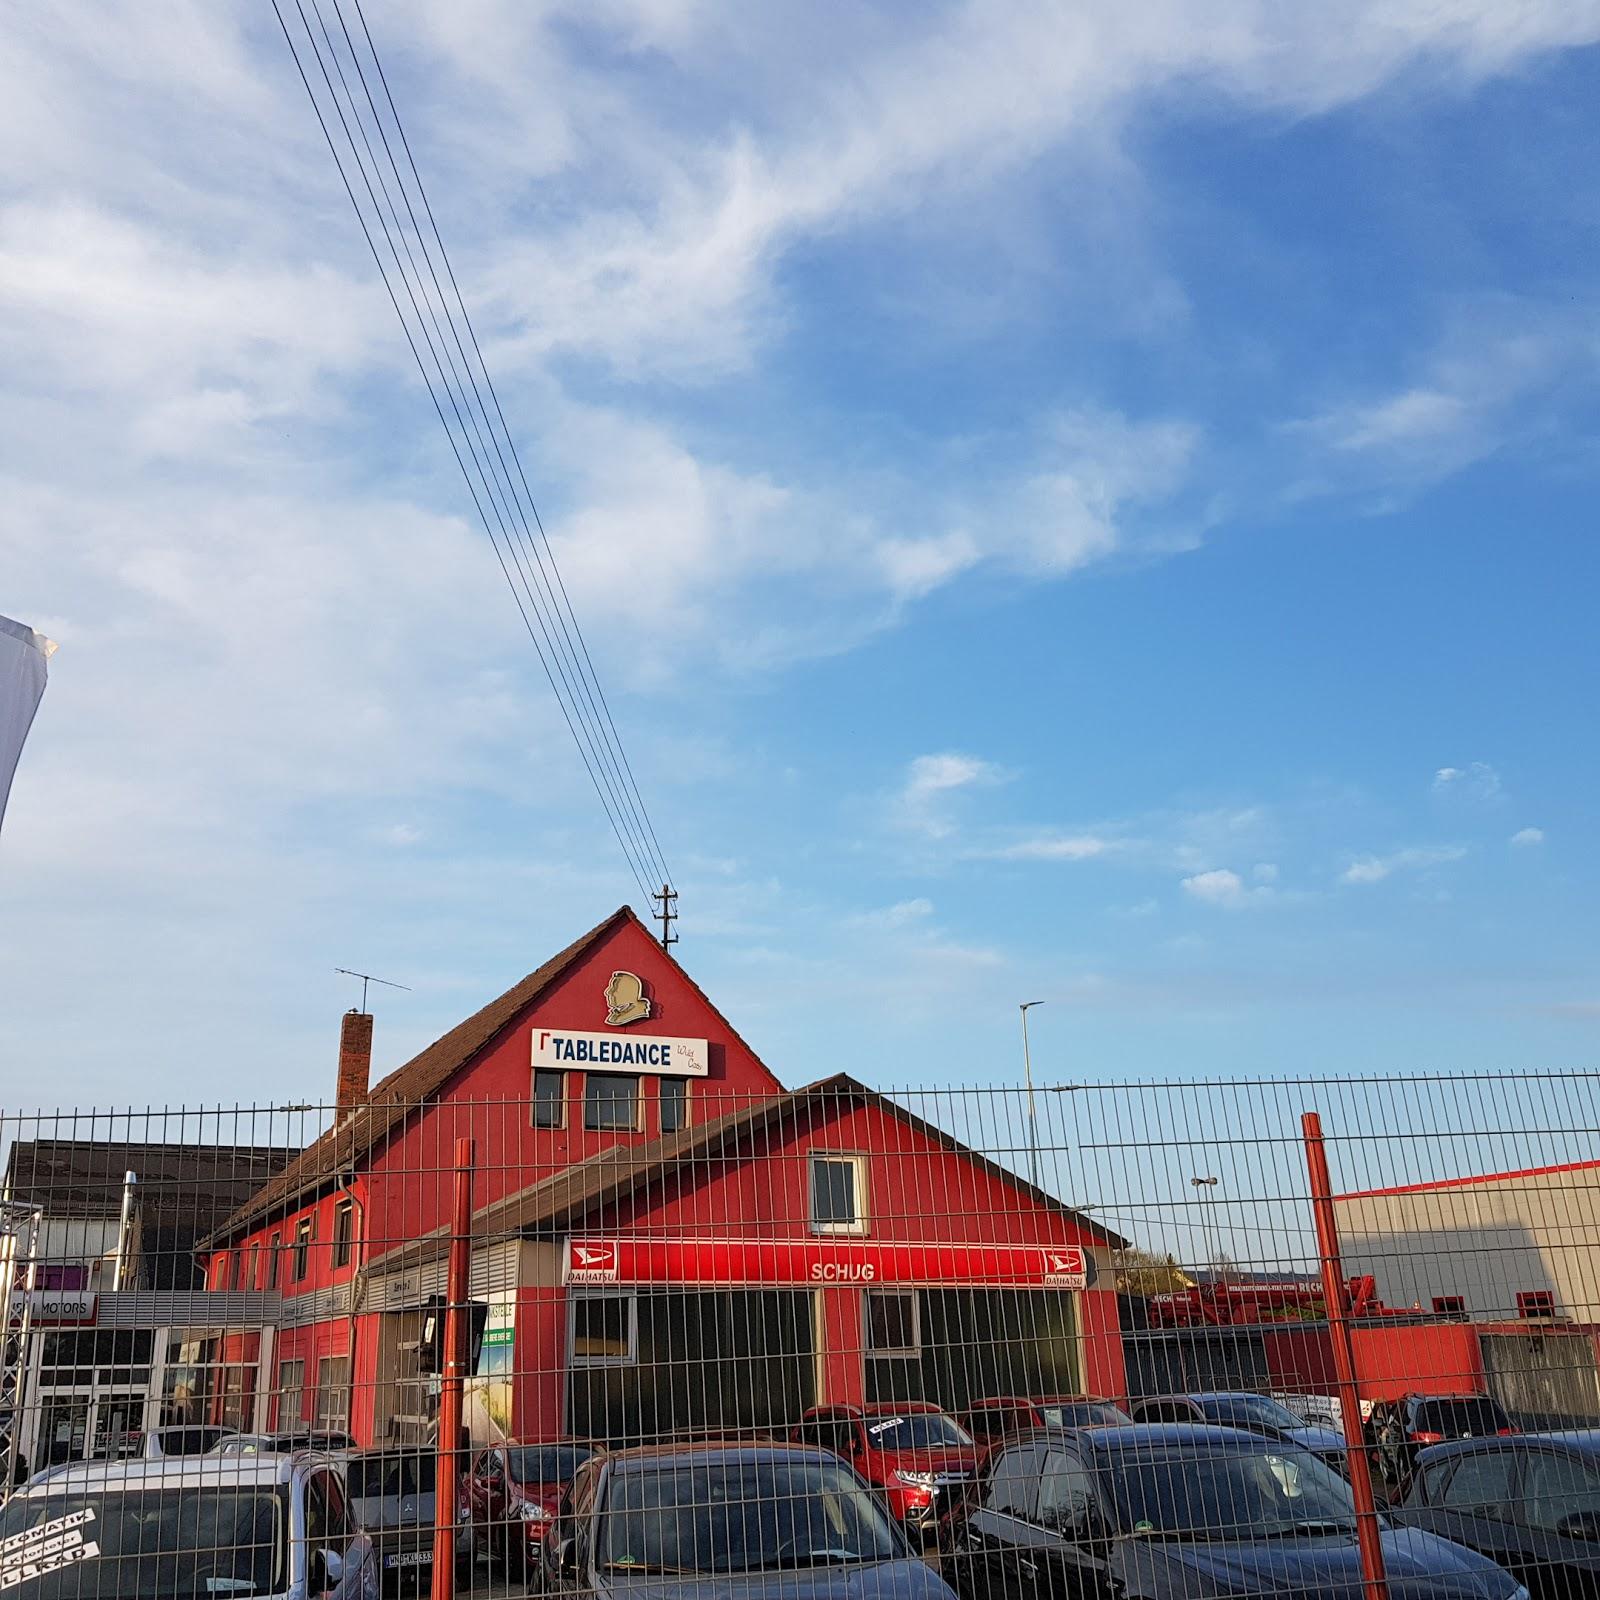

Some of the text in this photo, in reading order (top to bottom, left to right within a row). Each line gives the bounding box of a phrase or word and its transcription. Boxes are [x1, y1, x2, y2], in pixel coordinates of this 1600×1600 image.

[552, 1038, 671, 1066] TABLEDANCE
[567, 1273, 614, 1281] DAIHATSU
[811, 1263, 875, 1280] SCHUG
[42, 1302, 87, 1314] MOTORS
